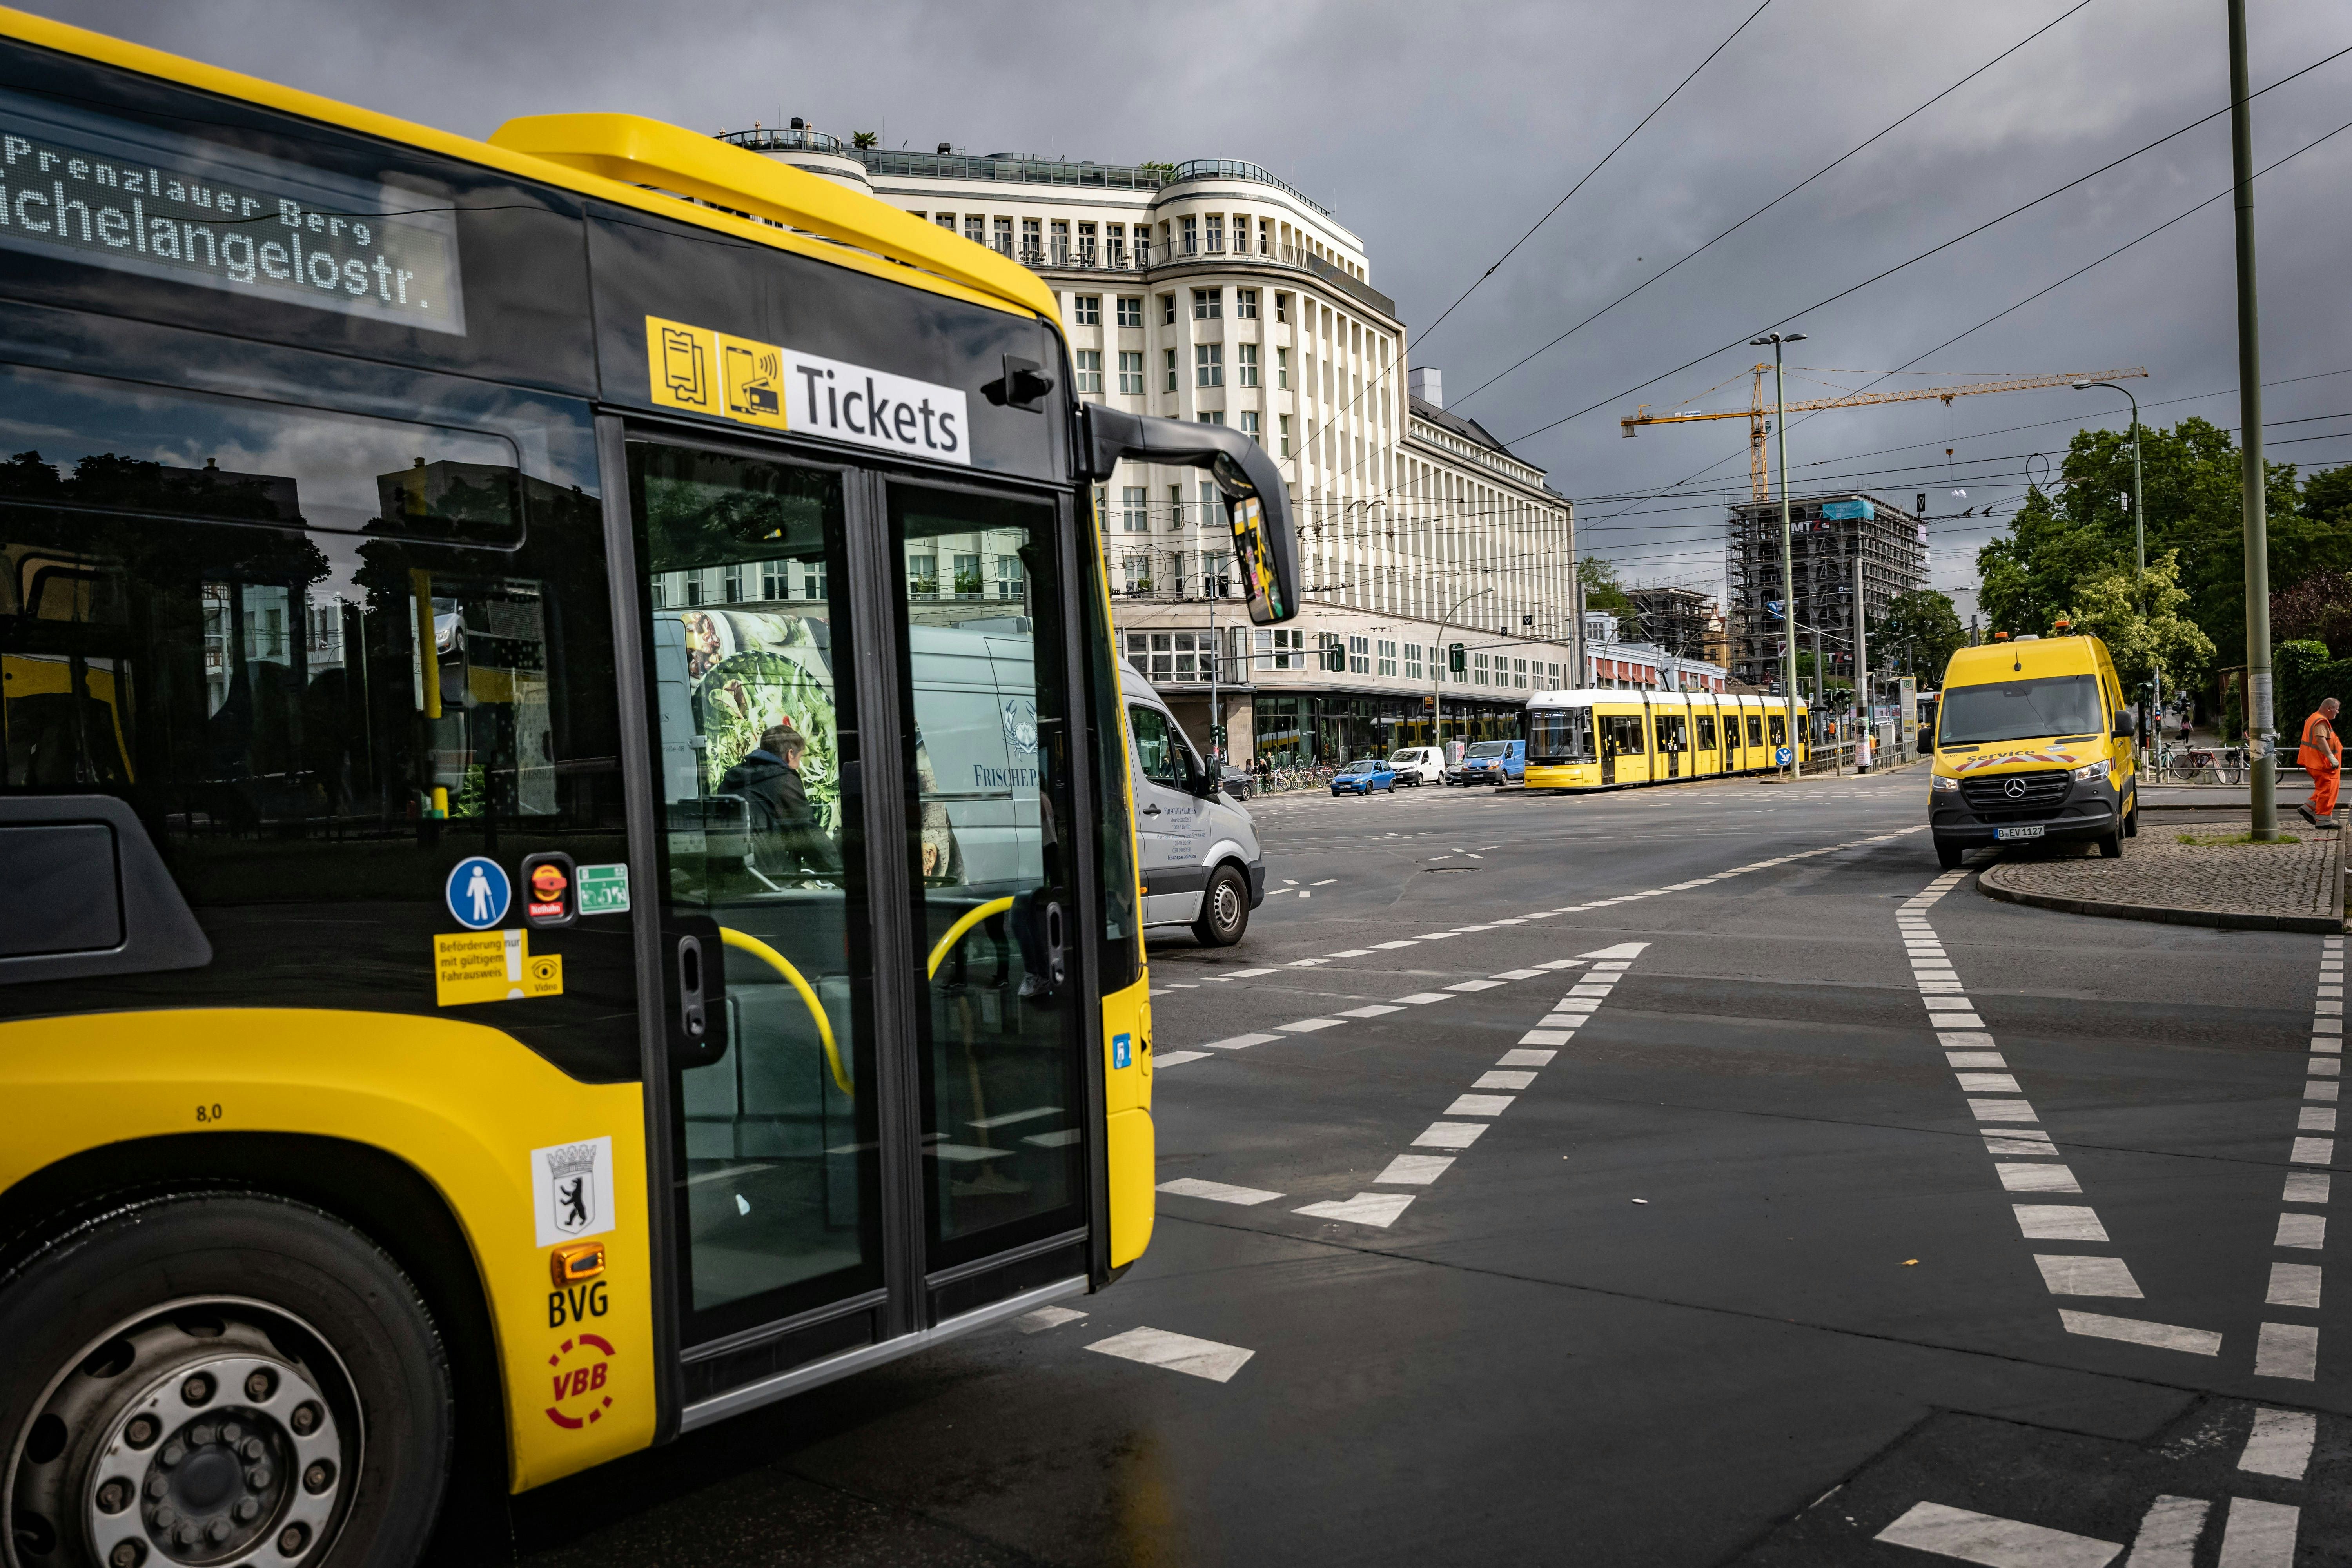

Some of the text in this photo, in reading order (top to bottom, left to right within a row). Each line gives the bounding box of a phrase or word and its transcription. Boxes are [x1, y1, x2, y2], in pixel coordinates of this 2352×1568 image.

[5, 134, 371, 245] Prenzlauer Berg
[796, 365, 957, 452] Tickets
[1791, 520, 1822, 533] MTZ
[1827, 652, 1844, 663] TZ
[1967, 750, 2035, 763] Service
[2022, 827, 2042, 836] 1127
[532, 904, 561, 913] Nothahn
[439, 939, 521, 953] Beförderung nur
[441, 953, 504, 968] mit gültigem
[441, 969, 502, 982] Fahrausweis
[534, 983, 558, 992] Video
[196, 1103, 222, 1123] 8,0
[549, 1281, 608, 1328] BVG
[553, 1362, 608, 1402] VBB
